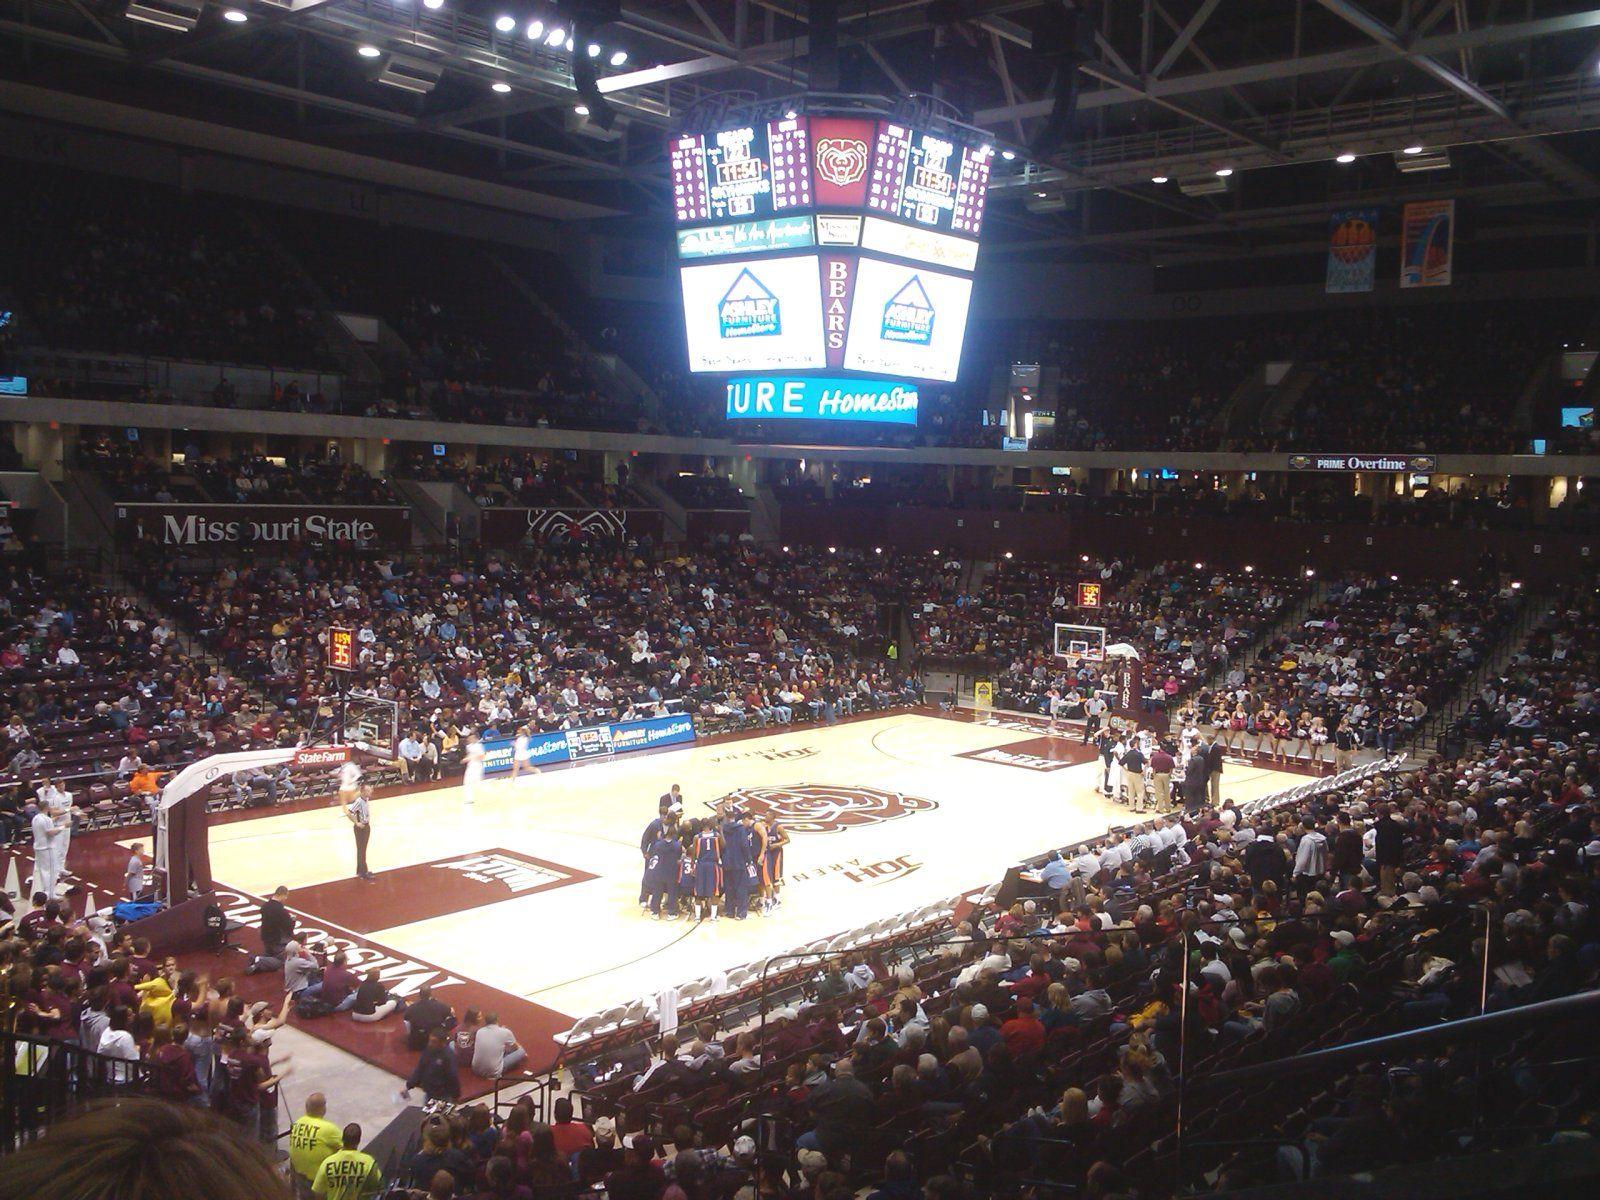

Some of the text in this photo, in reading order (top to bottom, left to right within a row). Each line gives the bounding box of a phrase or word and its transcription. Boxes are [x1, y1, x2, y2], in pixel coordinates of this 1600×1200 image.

[828, 261, 848, 349] BEARS
[1317, 459, 1345, 469] PRIME
[1347, 457, 1406, 470] Overtime
[334, 643, 350, 665] 35
[1121, 672, 1131, 709] BEARS
[705, 838, 711, 851] 1
[325, 1160, 365, 1177] EVENT
[327, 1175, 365, 1189] STAFF
